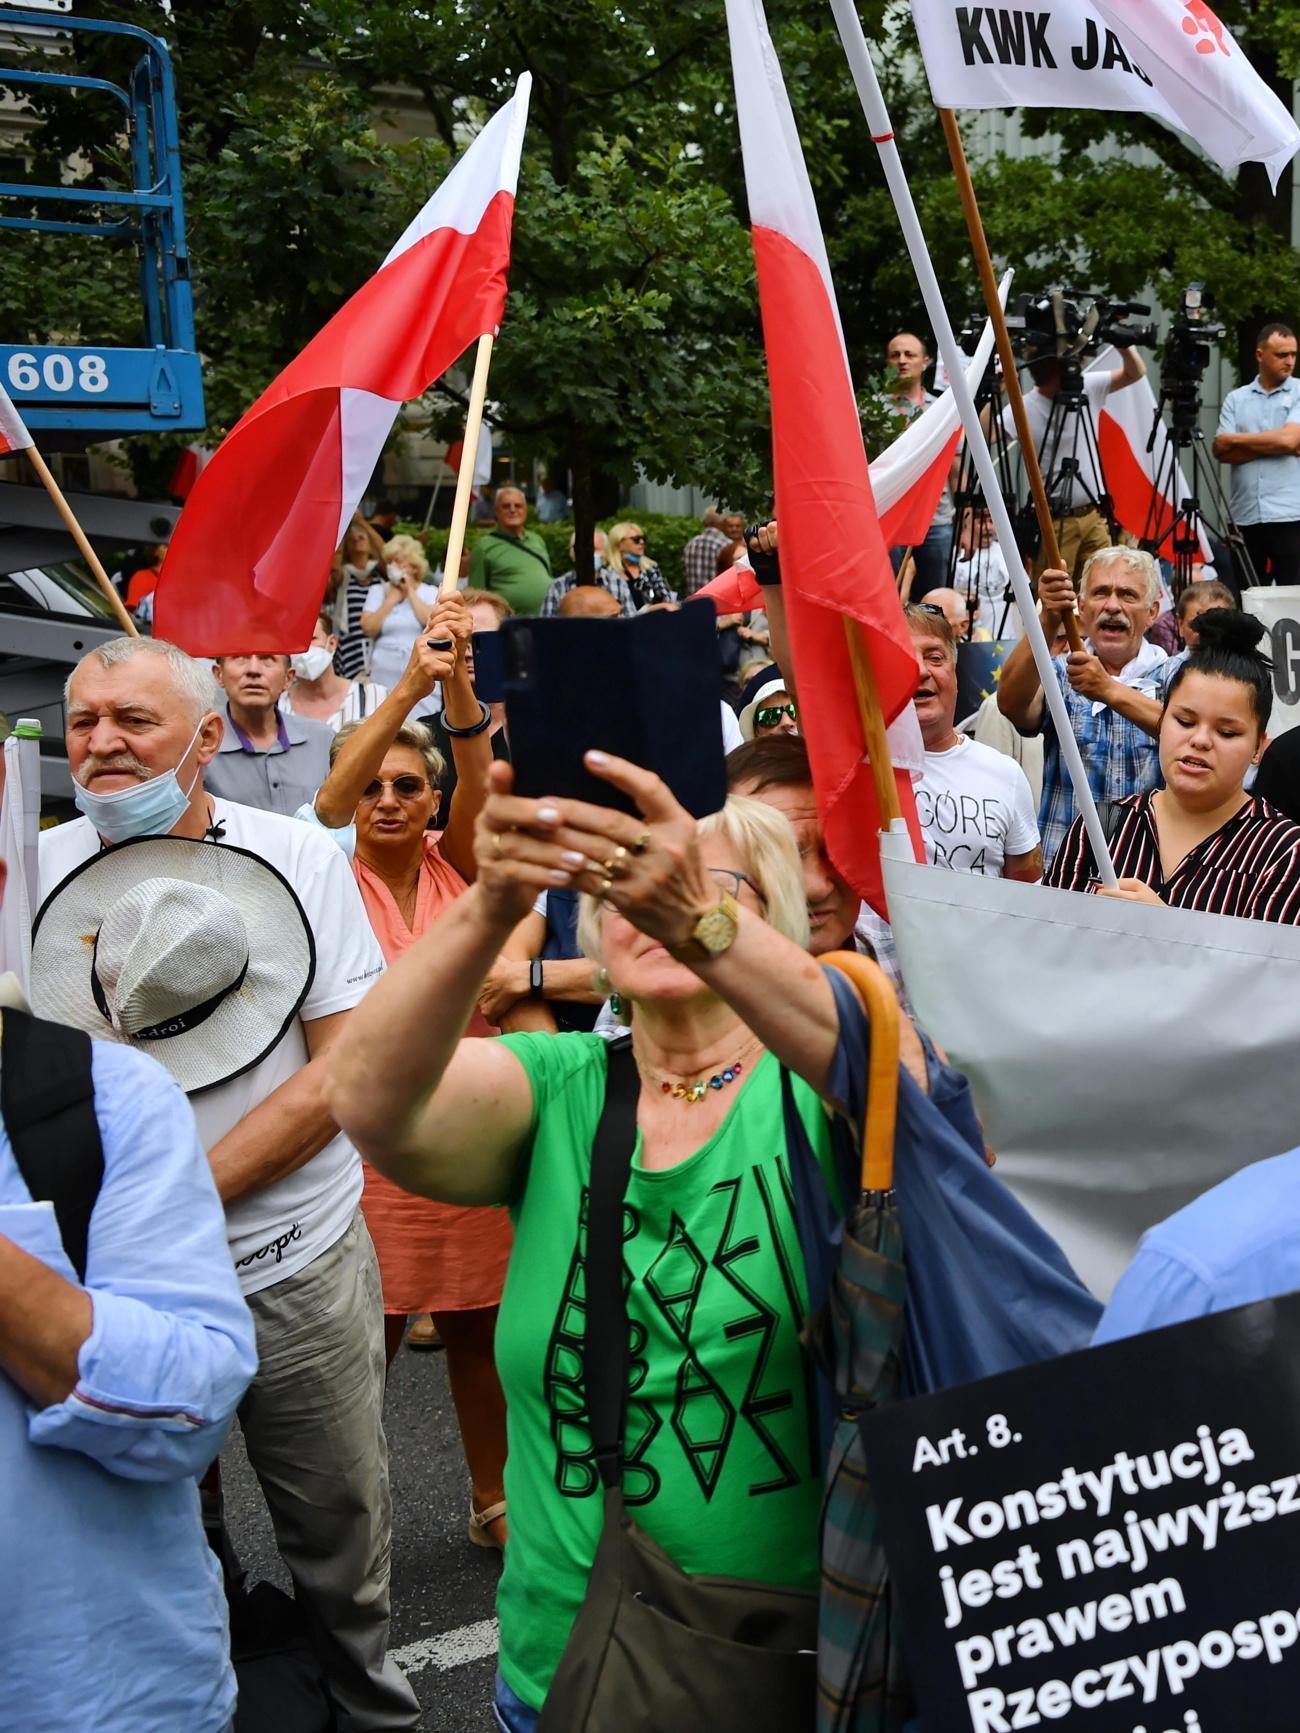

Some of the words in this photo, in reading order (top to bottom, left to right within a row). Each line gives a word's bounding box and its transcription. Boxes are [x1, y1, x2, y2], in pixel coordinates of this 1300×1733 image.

[955, 7, 1058, 69] KWK
[8, 352, 109, 393] 608
[912, 1428, 979, 1473] Art.
[985, 1413, 1022, 1449] 8.
[925, 1424, 1255, 1552] Konstytucja
[938, 1544, 1044, 1629] jest
[955, 1577, 1186, 1690] prawem
